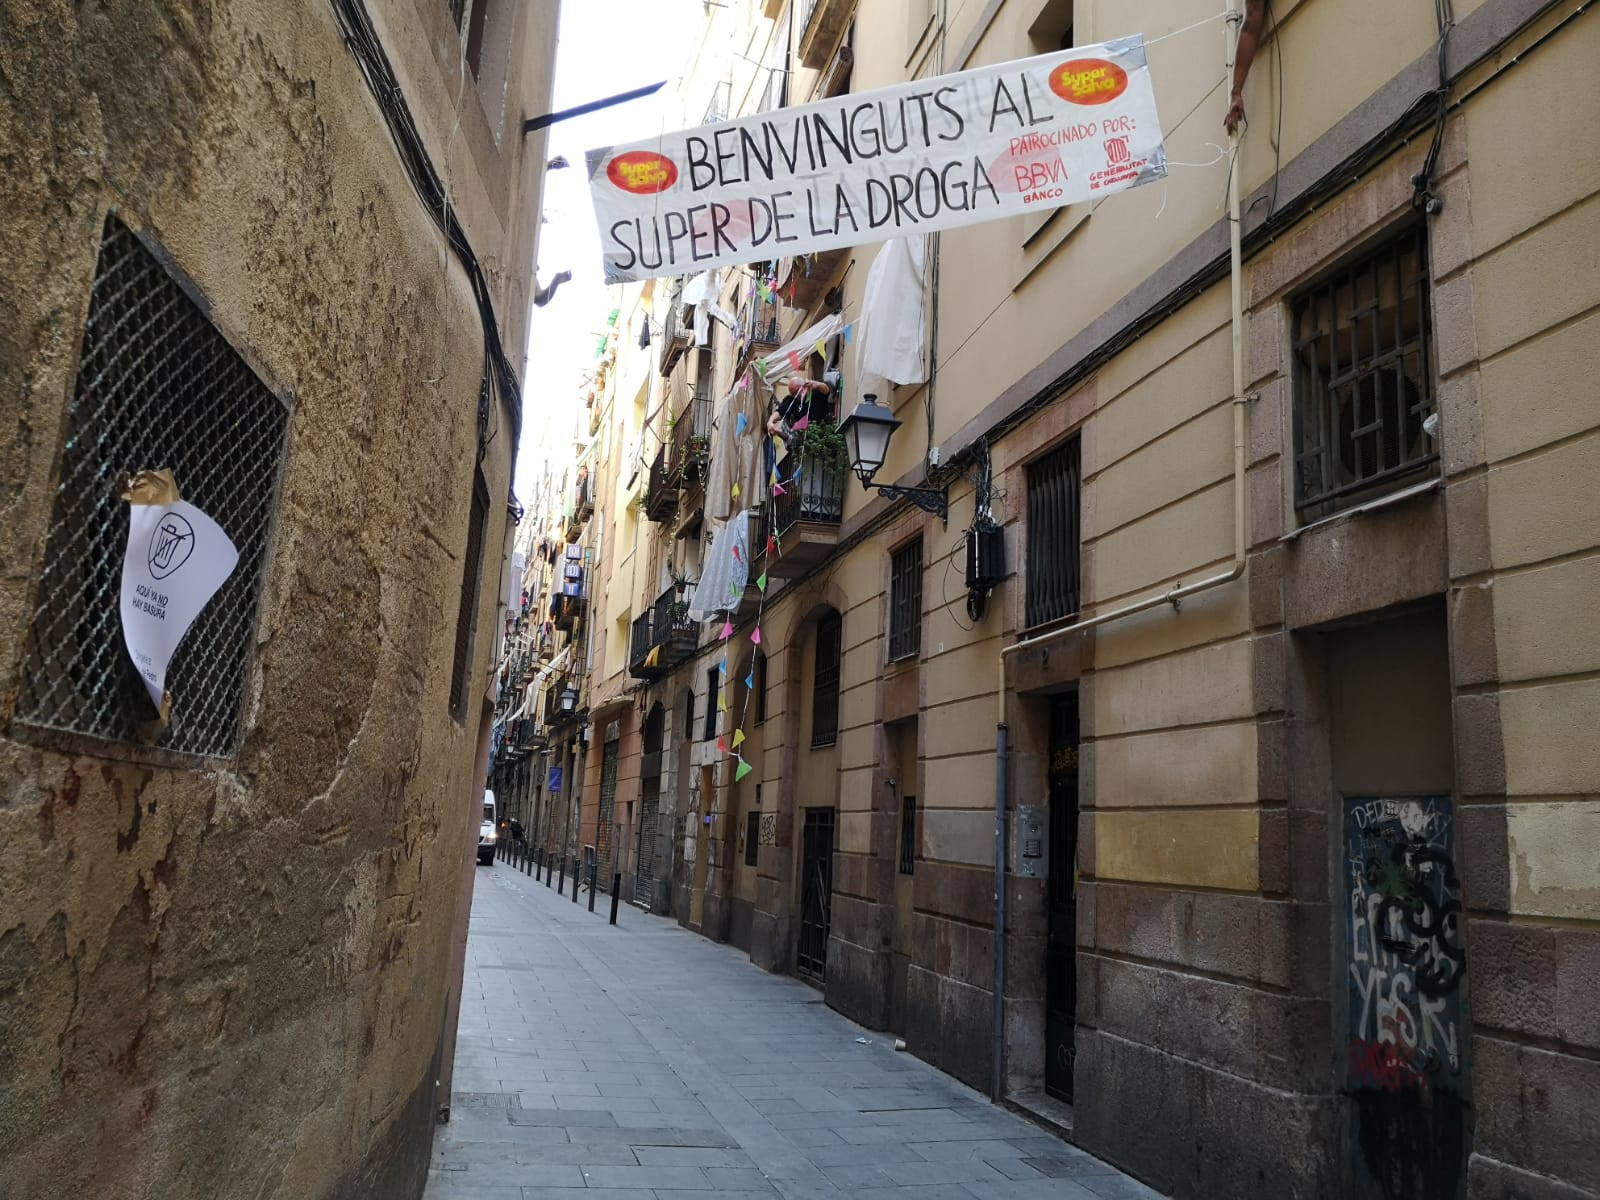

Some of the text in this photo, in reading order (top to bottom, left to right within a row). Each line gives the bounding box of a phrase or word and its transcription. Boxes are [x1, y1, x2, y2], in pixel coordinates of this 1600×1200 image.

[1062, 67, 1107, 86] Super
[1072, 77, 1115, 96] Salva
[686, 73, 1053, 191] BENVINGUTS AL
[1010, 116, 1137, 156] PATROCINADO POR:
[619, 160, 660, 177] Super
[1014, 157, 1068, 193] BBVA
[1024, 188, 1063, 204] BANCO
[610, 155, 999, 270] SUPER DE LA DROGA
[132, 596, 166, 621] HAY BASURA
[158, 593, 169, 607] NO
